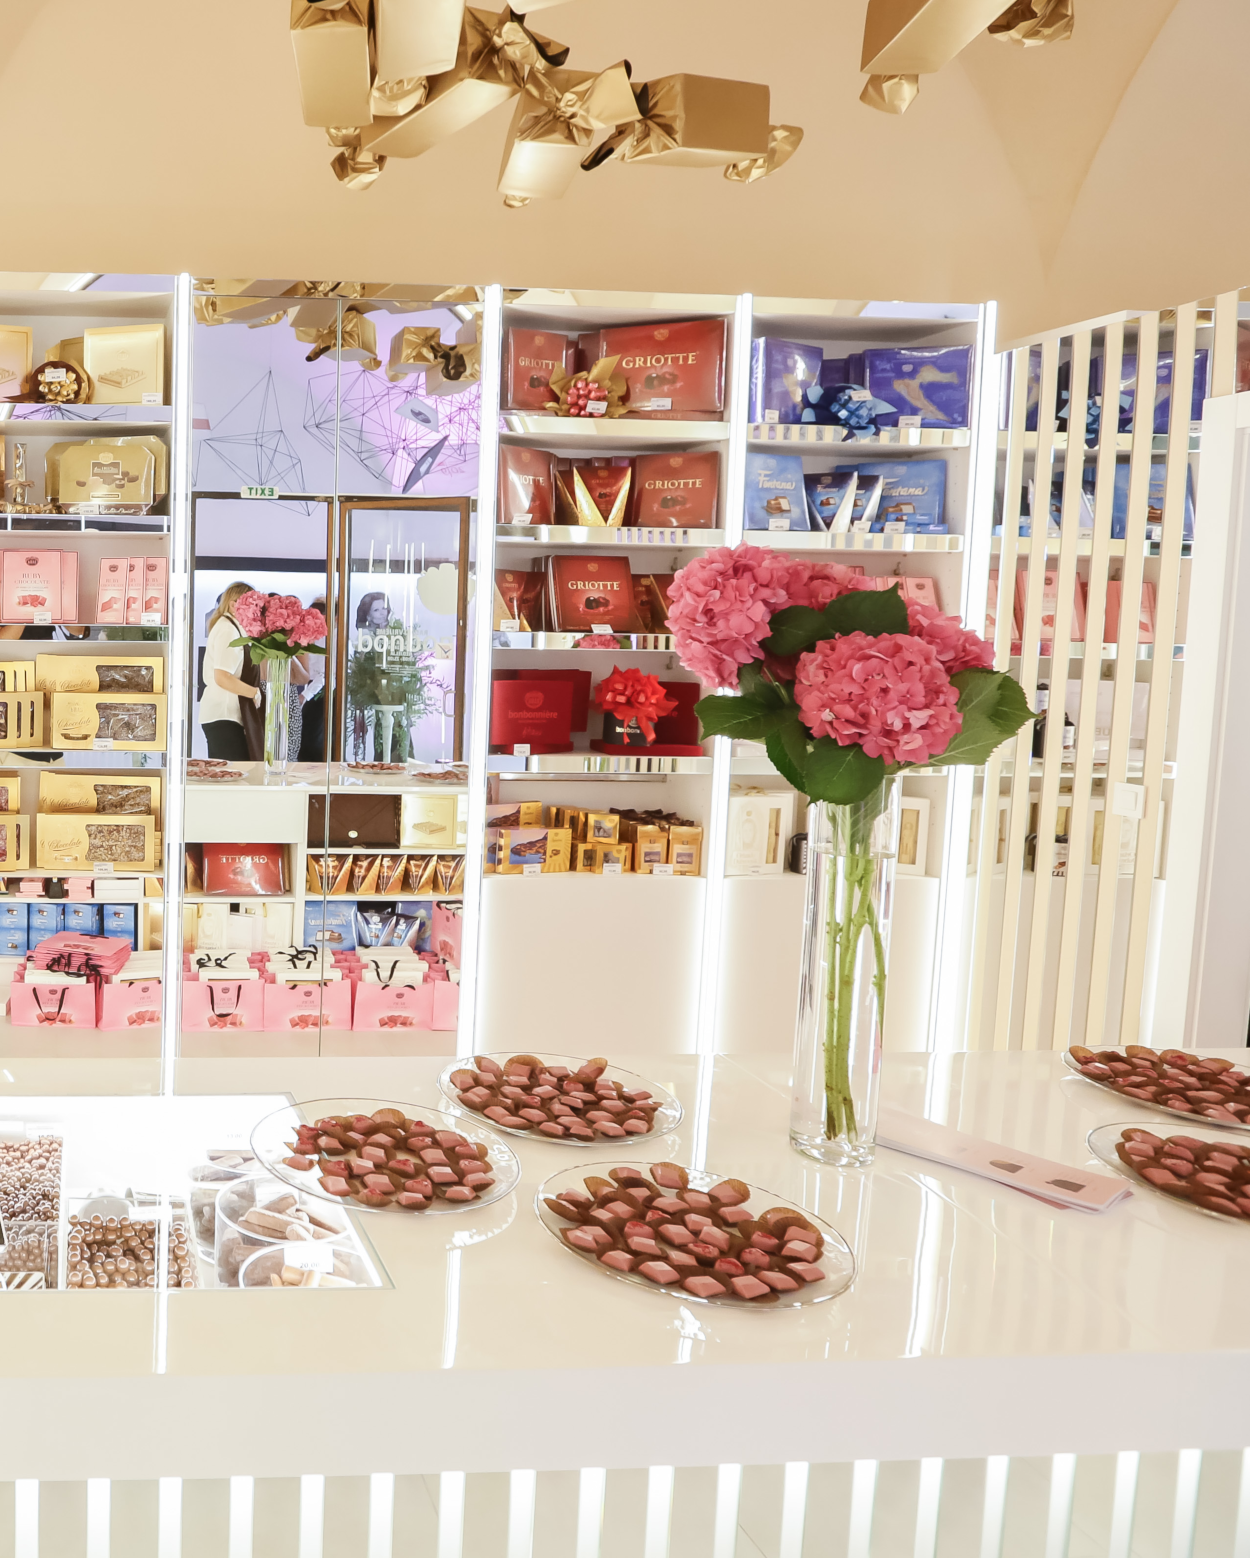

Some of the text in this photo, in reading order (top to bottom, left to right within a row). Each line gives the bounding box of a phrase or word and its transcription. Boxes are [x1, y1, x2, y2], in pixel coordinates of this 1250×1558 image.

[519, 357, 557, 370] GRIOTT
[622, 352, 698, 369] GRIOTTE
[645, 479, 703, 490] GRIOTTE
[757, 470, 796, 489] Fontana
[882, 478, 929, 496] Fontana
[568, 581, 620, 591] GRIOTTE
[508, 709, 558, 718] bonbonnière
[56, 717, 93, 730] Chocolate
[56, 797, 91, 809] Chocolate
[47, 839, 83, 852] Chocolate
